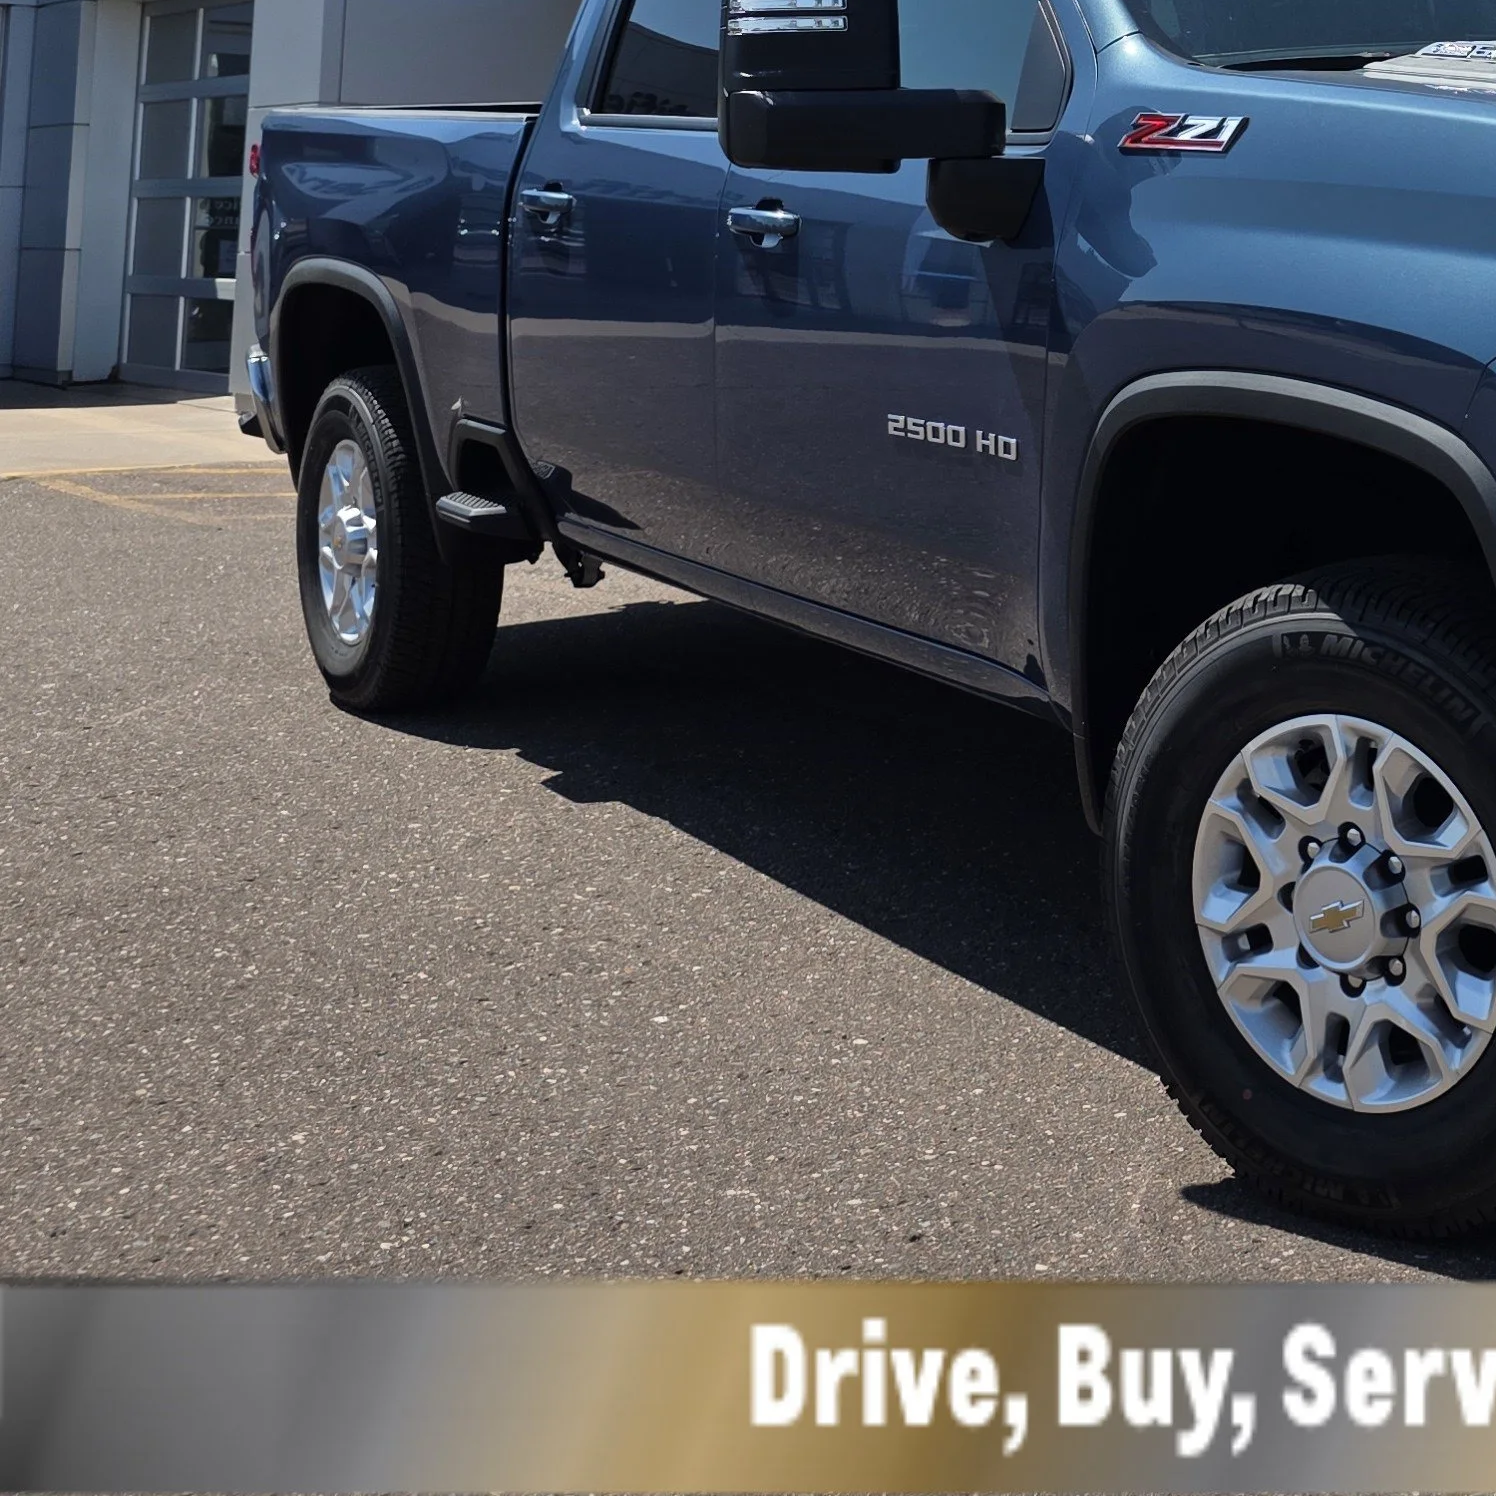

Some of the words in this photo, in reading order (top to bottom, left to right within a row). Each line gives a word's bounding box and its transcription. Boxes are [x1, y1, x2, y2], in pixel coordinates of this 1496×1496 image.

[1117, 112, 1249, 154] Z71
[888, 414, 966, 448] 2500
[976, 430, 1017, 461] HD
[1318, 633, 1481, 726] MICHELIN
